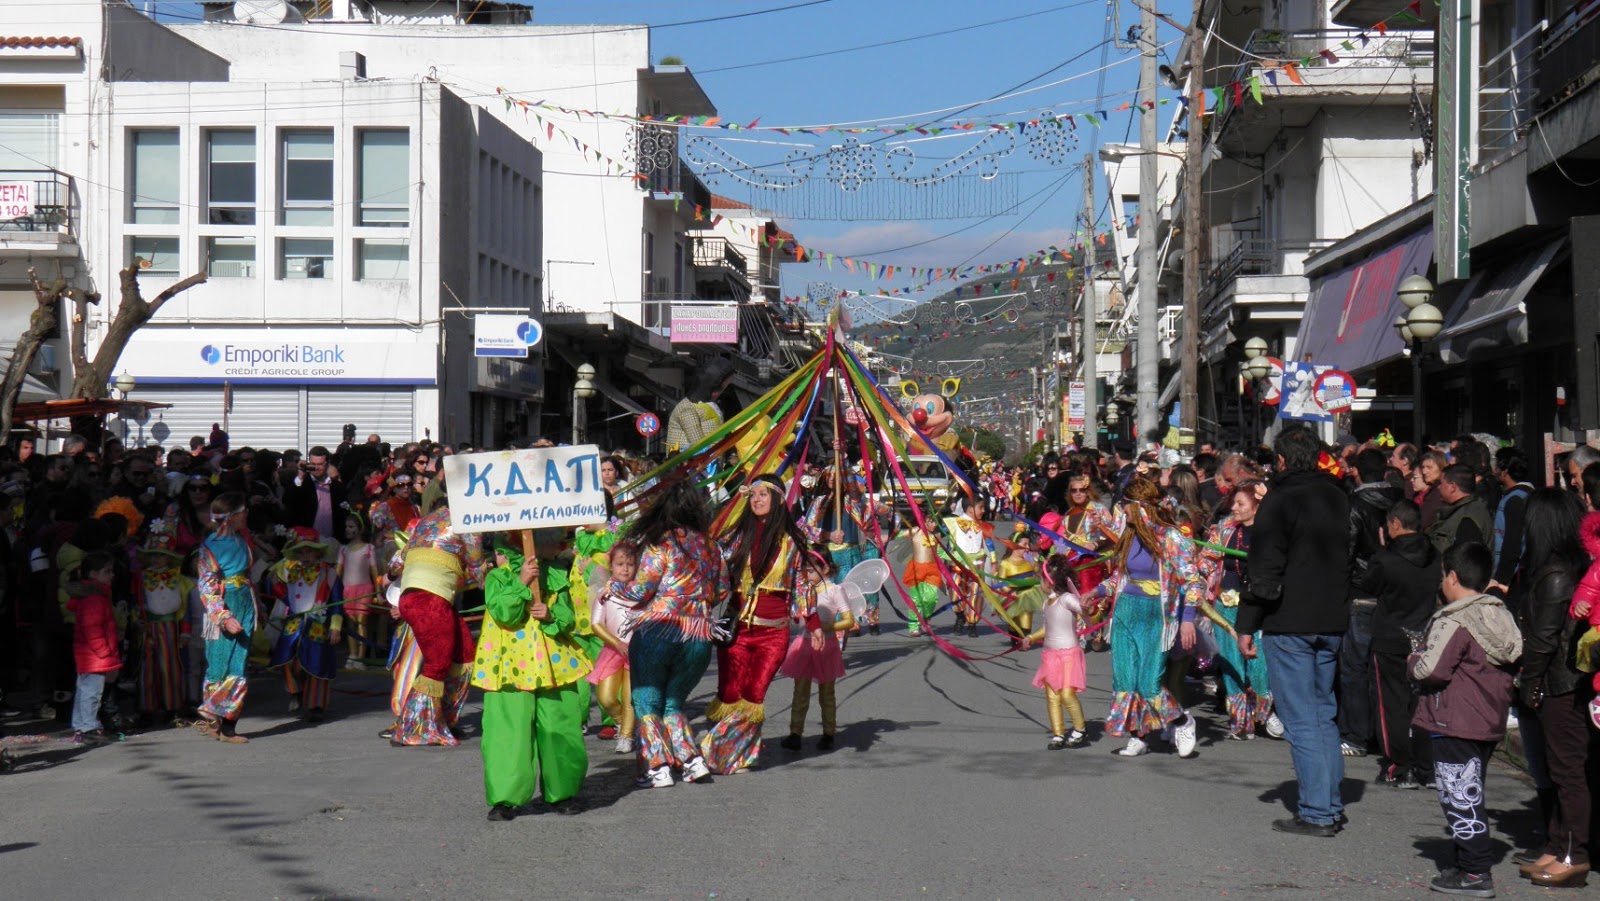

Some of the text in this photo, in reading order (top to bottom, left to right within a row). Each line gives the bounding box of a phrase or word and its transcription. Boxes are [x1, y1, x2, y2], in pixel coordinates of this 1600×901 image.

[225, 344, 345, 367] Emporiki Bank
[311, 368, 345, 376] GROUP
[463, 503, 607, 526] ΔΗΜΟΥ ΜΕΓΑΛΟΠΟΛΗΣ
